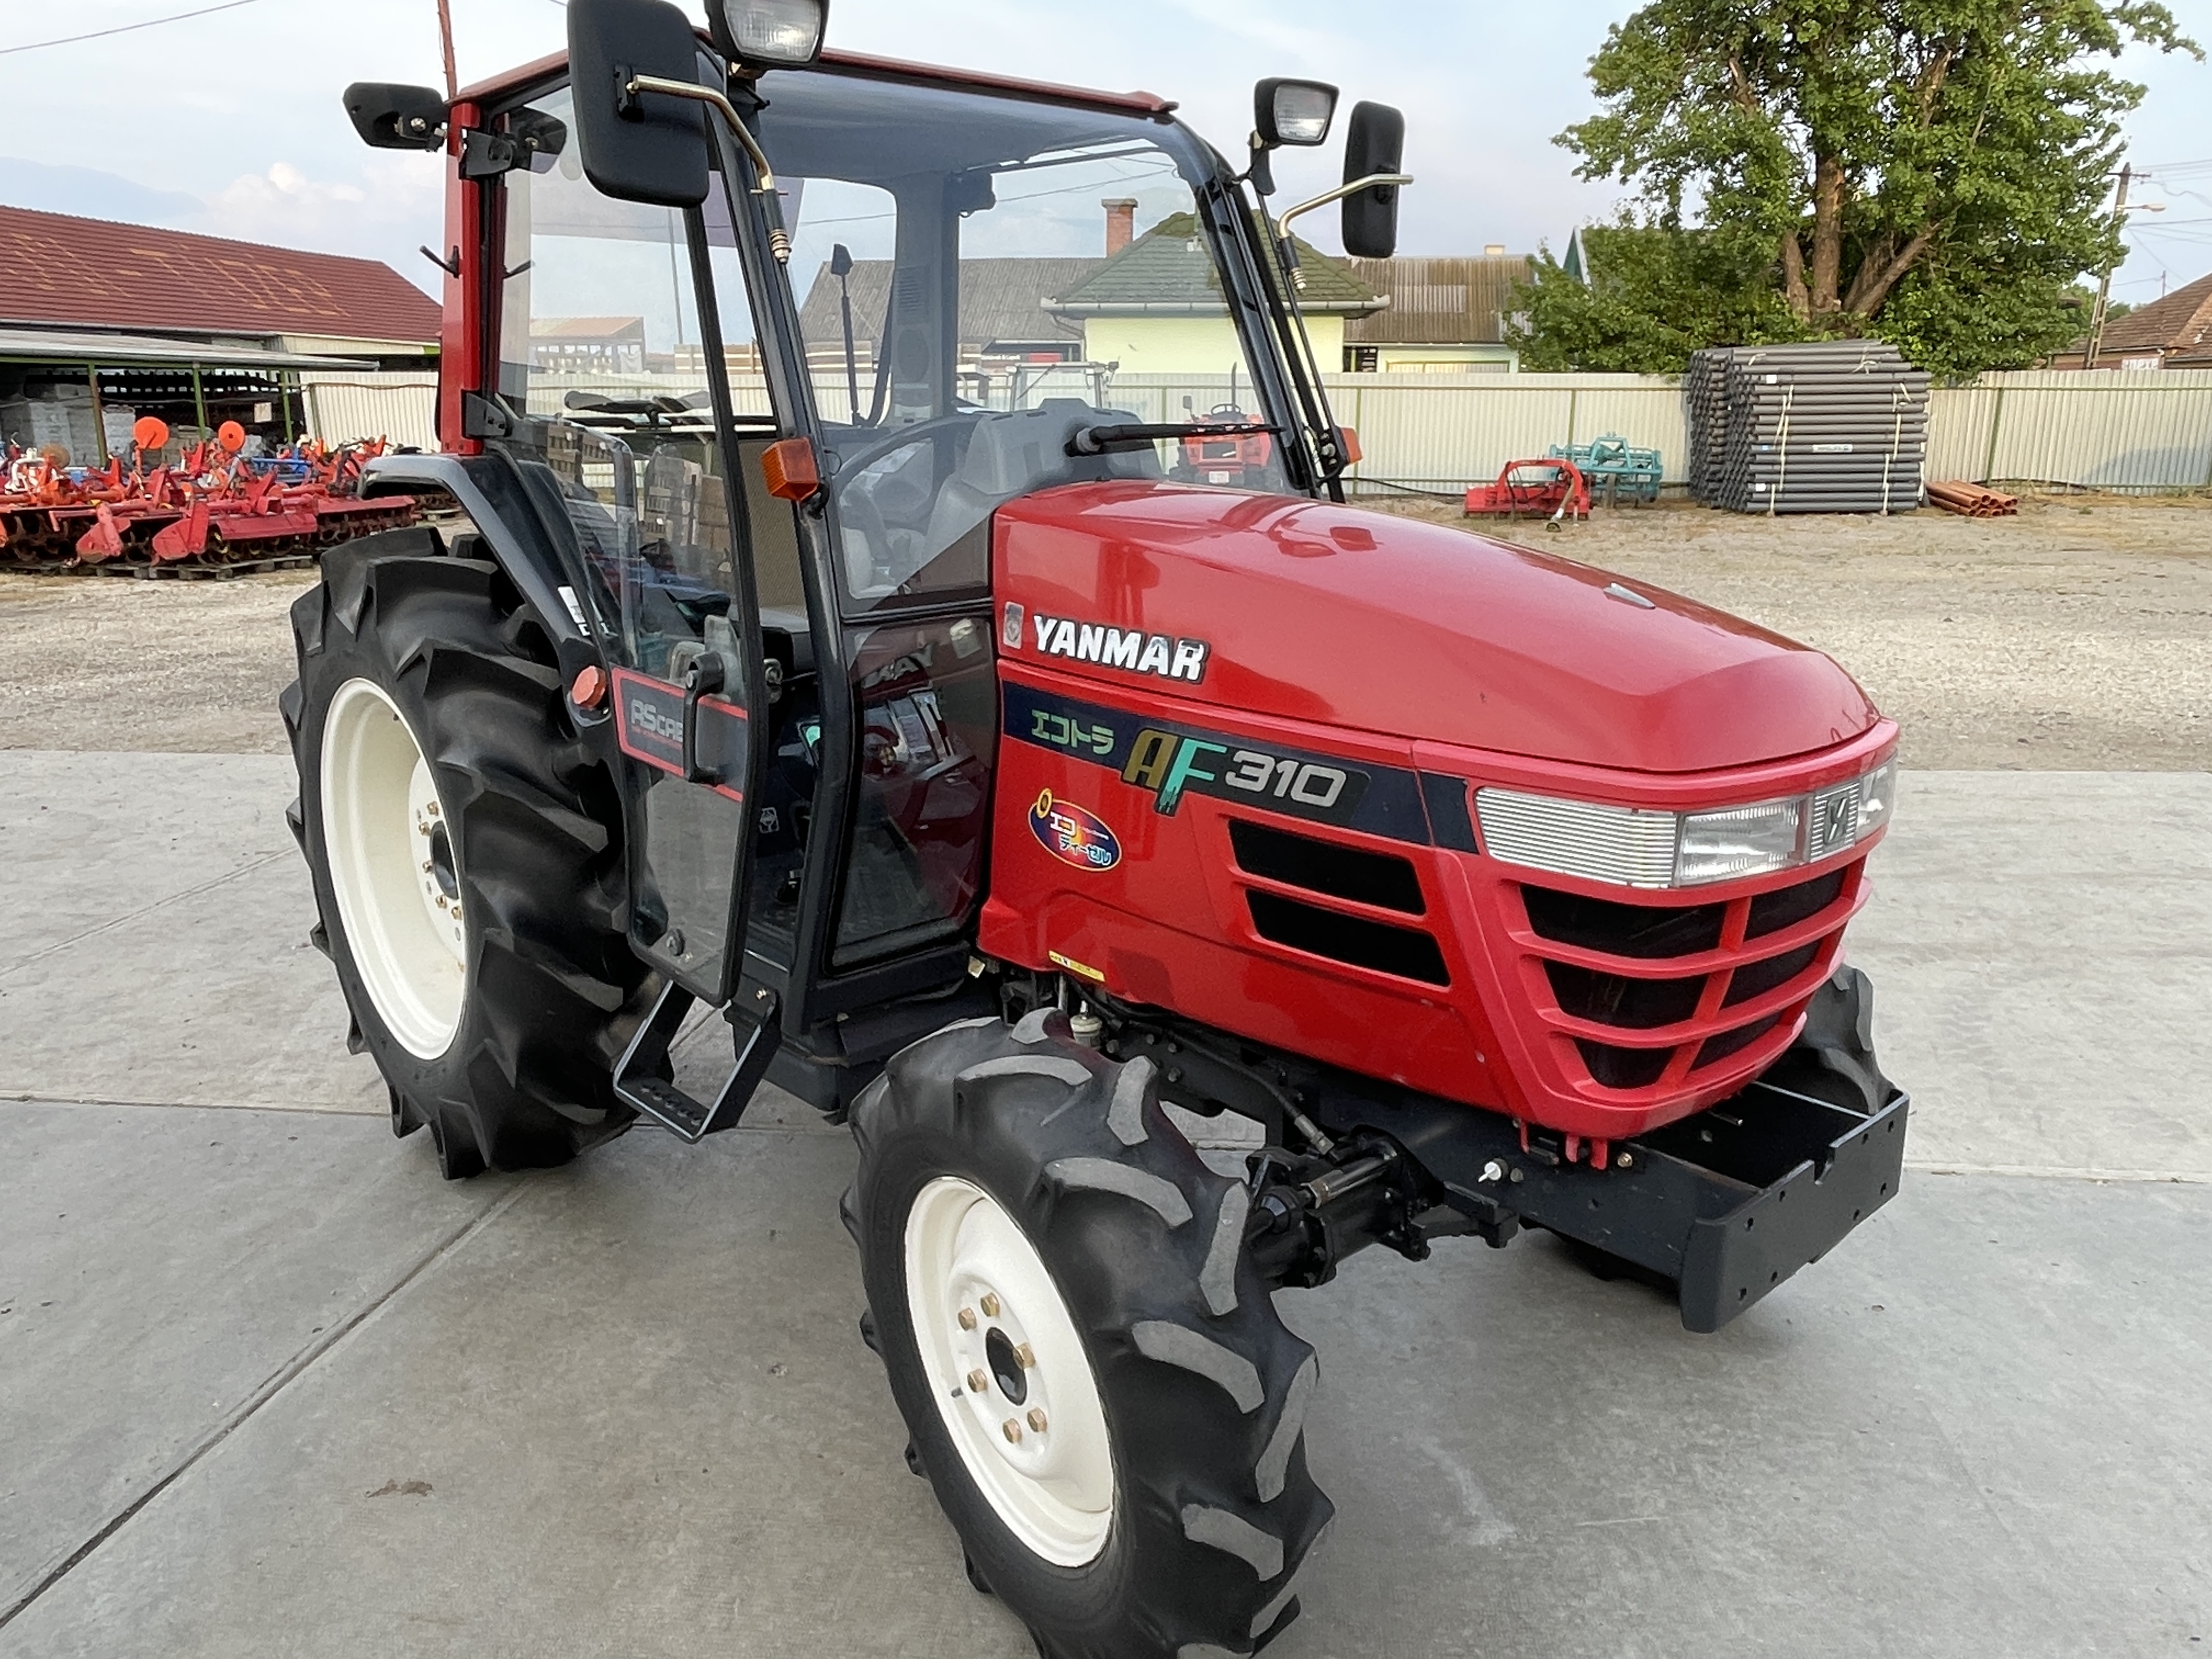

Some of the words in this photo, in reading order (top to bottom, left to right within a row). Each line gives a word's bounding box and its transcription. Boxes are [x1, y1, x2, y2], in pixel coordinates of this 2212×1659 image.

[1034, 614, 1207, 681] YANMAR
[1031, 709, 1115, 755] エコトラ
